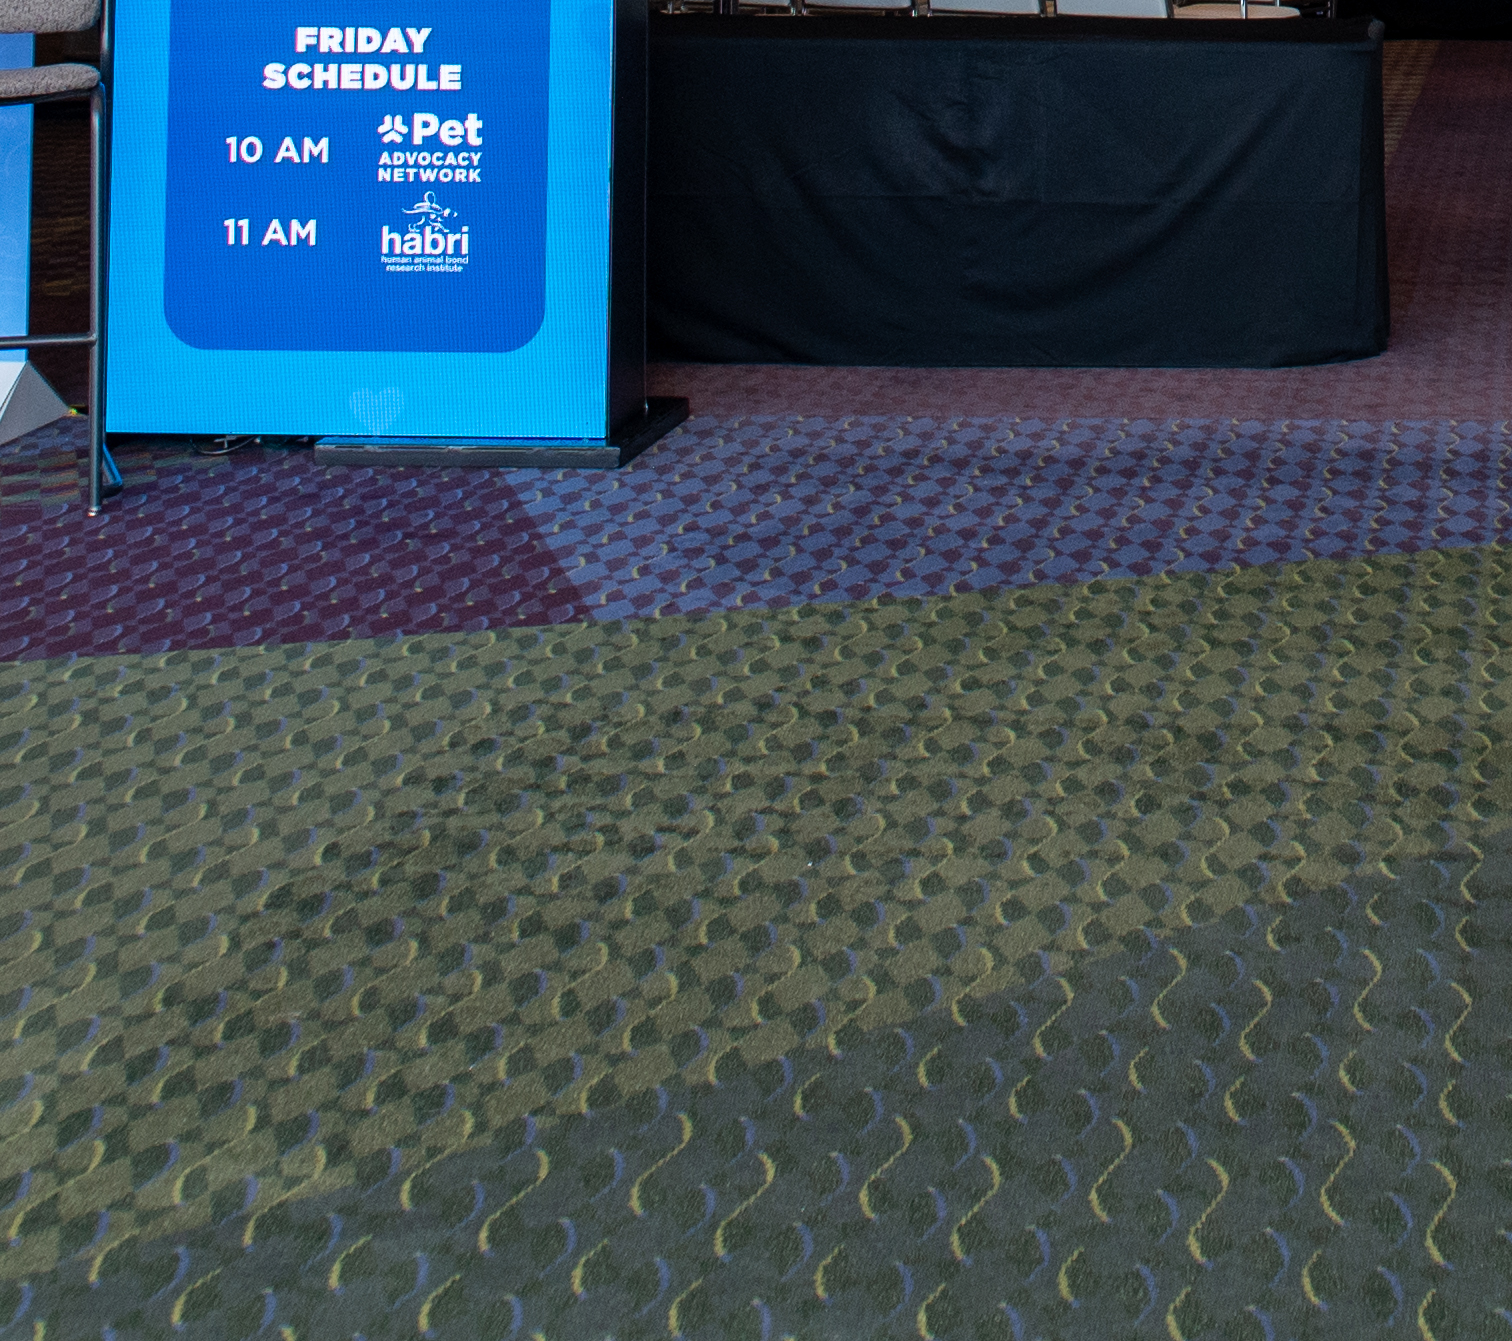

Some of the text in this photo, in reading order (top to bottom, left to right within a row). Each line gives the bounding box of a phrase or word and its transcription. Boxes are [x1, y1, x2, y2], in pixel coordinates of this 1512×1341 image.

[295, 27, 431, 53] FRIDAY
[263, 64, 461, 90] SCHEDULE
[413, 113, 482, 146] Pet
[226, 137, 328, 163] 10 AM
[379, 152, 480, 166] ADVOCACY
[378, 168, 480, 182] NETWORK
[224, 219, 316, 246] 11 AM
[382, 224, 468, 254] habri
